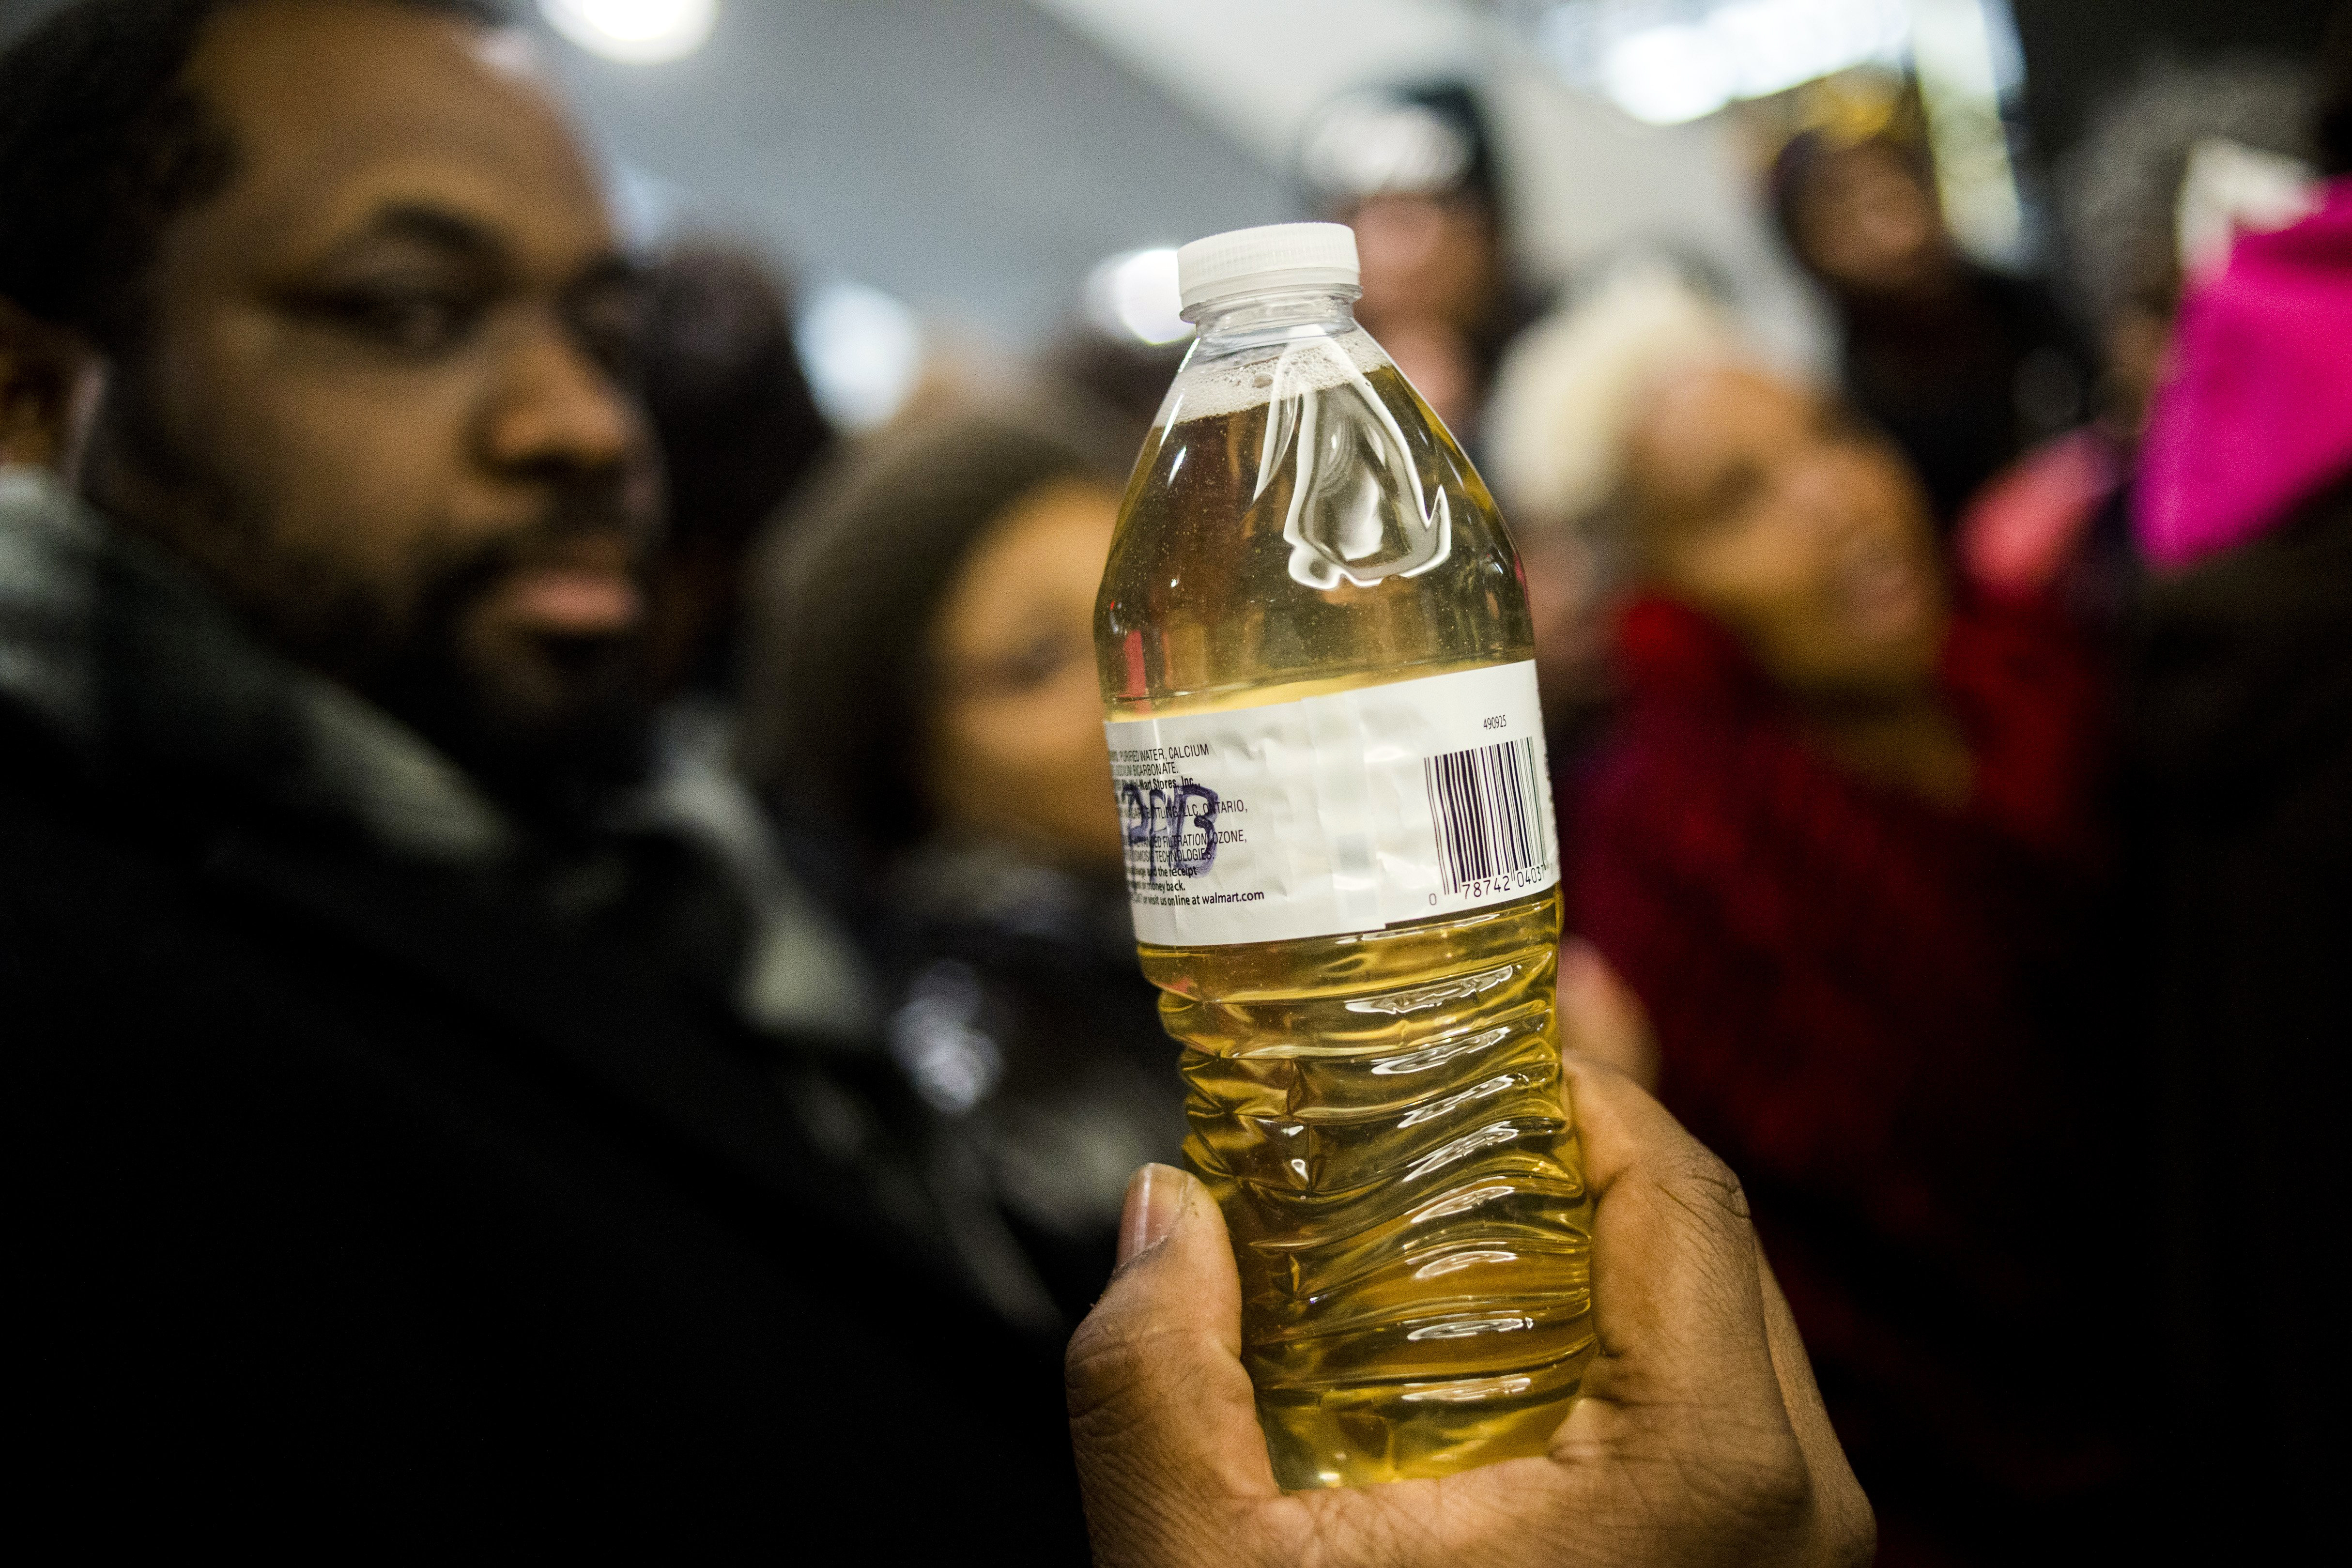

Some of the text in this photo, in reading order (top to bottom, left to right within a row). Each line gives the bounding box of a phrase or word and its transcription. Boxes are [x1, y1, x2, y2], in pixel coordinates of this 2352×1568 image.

[1483, 715, 1507, 730] 490925
[1139, 748, 1168, 762] WATER,
[1168, 743, 1210, 759] CALCIUM
[1133, 762, 1178, 777] BICARBONATE.
[1213, 830, 1247, 845] OZONE,
[1158, 865, 1168, 877] the
[1169, 866, 1198, 878] receipt
[1166, 879, 1185, 892] back.
[1429, 893, 1437, 906] 0
[1462, 875, 1511, 900] 78742
[1160, 897, 1167, 906] us
[1192, 895, 1200, 905] at
[1202, 892, 1264, 904] walmart.com
